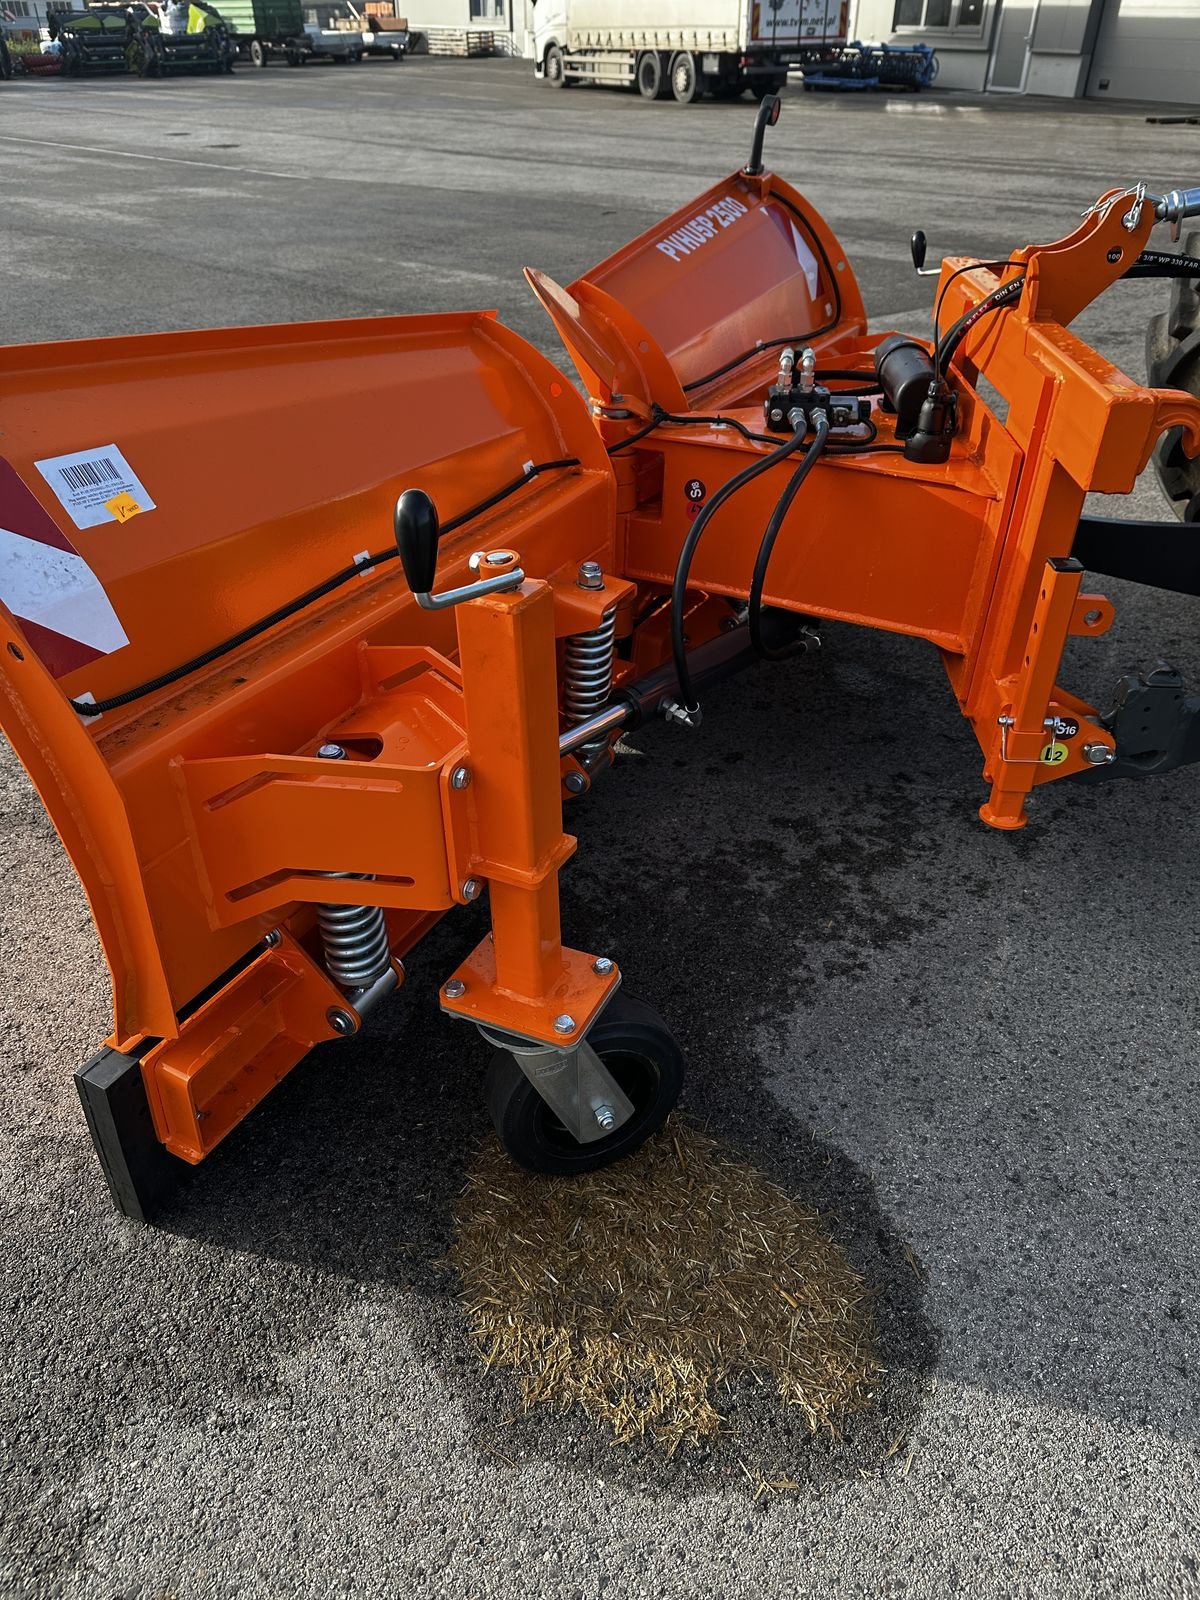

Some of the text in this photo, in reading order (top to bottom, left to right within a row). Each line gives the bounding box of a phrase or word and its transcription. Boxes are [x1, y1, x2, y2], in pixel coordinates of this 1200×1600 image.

[766, 15, 837, 28] www.tvm.netpl
[705, 195, 749, 229] 2500
[994, 288, 1008, 301] DIN
[1008, 281, 1021, 292] EN
[1056, 722, 1077, 735] S16
[1045, 747, 1063, 761] L2
